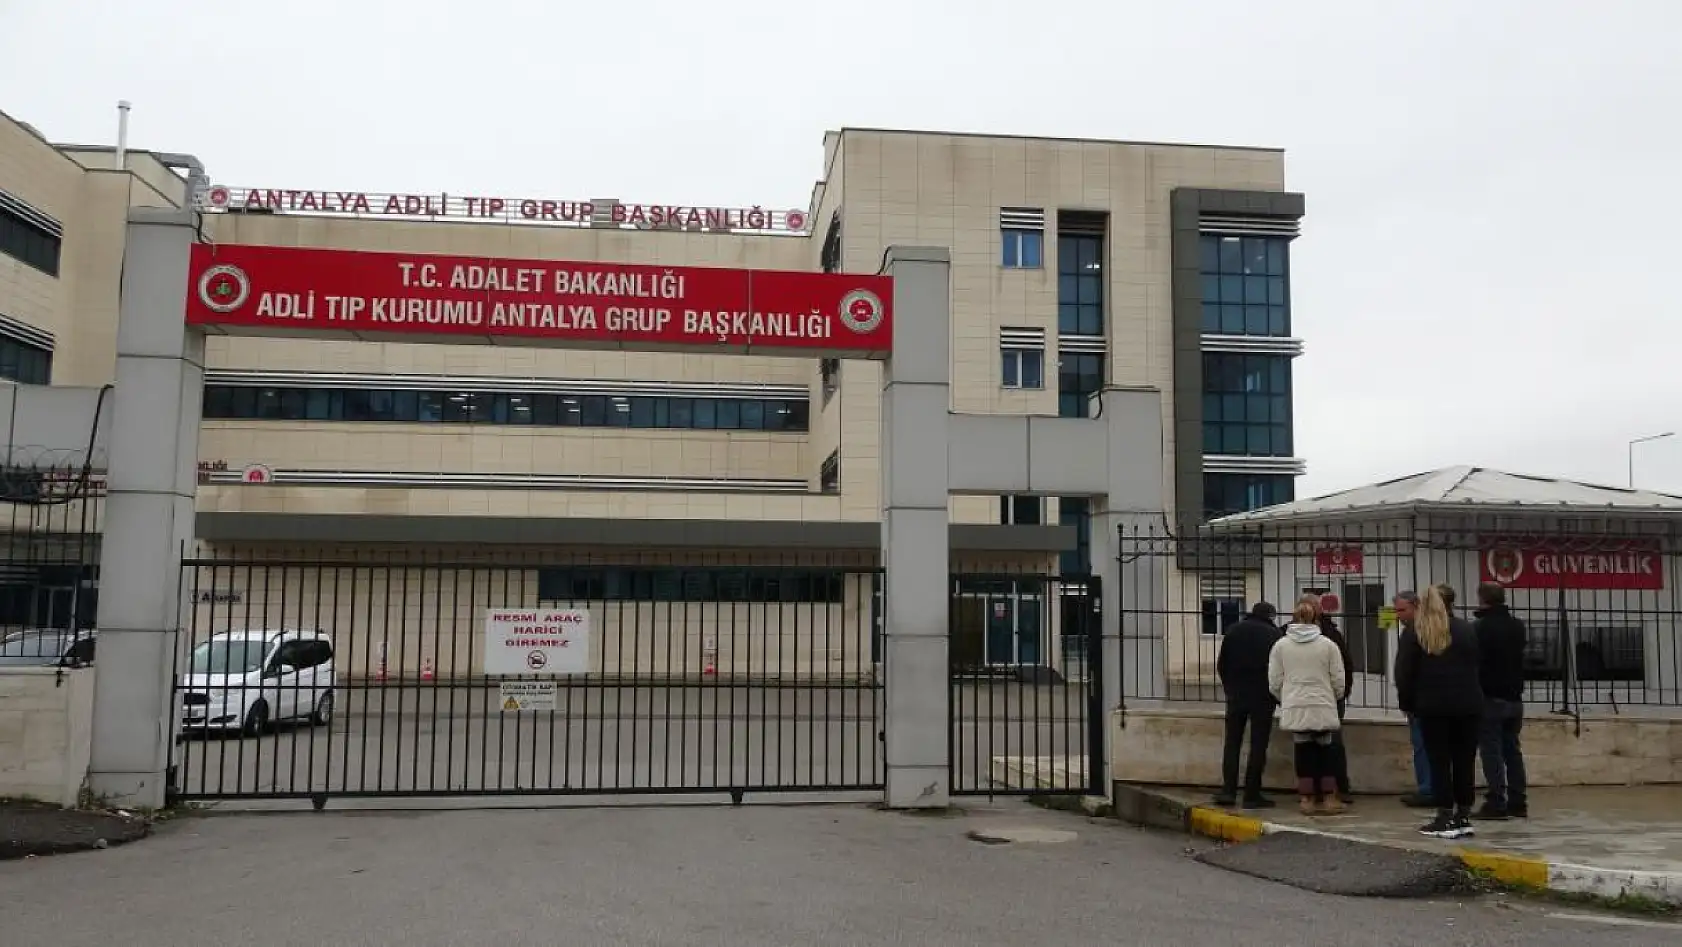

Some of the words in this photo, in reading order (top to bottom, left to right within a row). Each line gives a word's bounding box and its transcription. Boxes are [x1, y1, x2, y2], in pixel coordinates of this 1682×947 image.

[245, 188, 370, 212] ANTALYA
[384, 191, 446, 215] ADLİ
[464, 197, 504, 217] TIP
[520, 199, 595, 222] GRUP
[611, 204, 773, 230] BAŞKANLIĞI
[398, 262, 442, 288] T.C.
[450, 265, 547, 293] ADALET
[555, 268, 685, 299] BAKANLIĞI
[256, 290, 315, 318] ADLİ
[325, 296, 366, 321] TIP
[372, 298, 483, 325] KURUMU
[490, 302, 598, 330] ANTALYA
[605, 307, 671, 332] GRUP
[684, 308, 831, 341] BAŞKANLIĞI
[1533, 550, 1653, 574] GÜVENLİK
[494, 612, 537, 622] RESMİ
[543, 614, 583, 625] ARAÇ
[513, 625, 563, 635] HARİCİ
